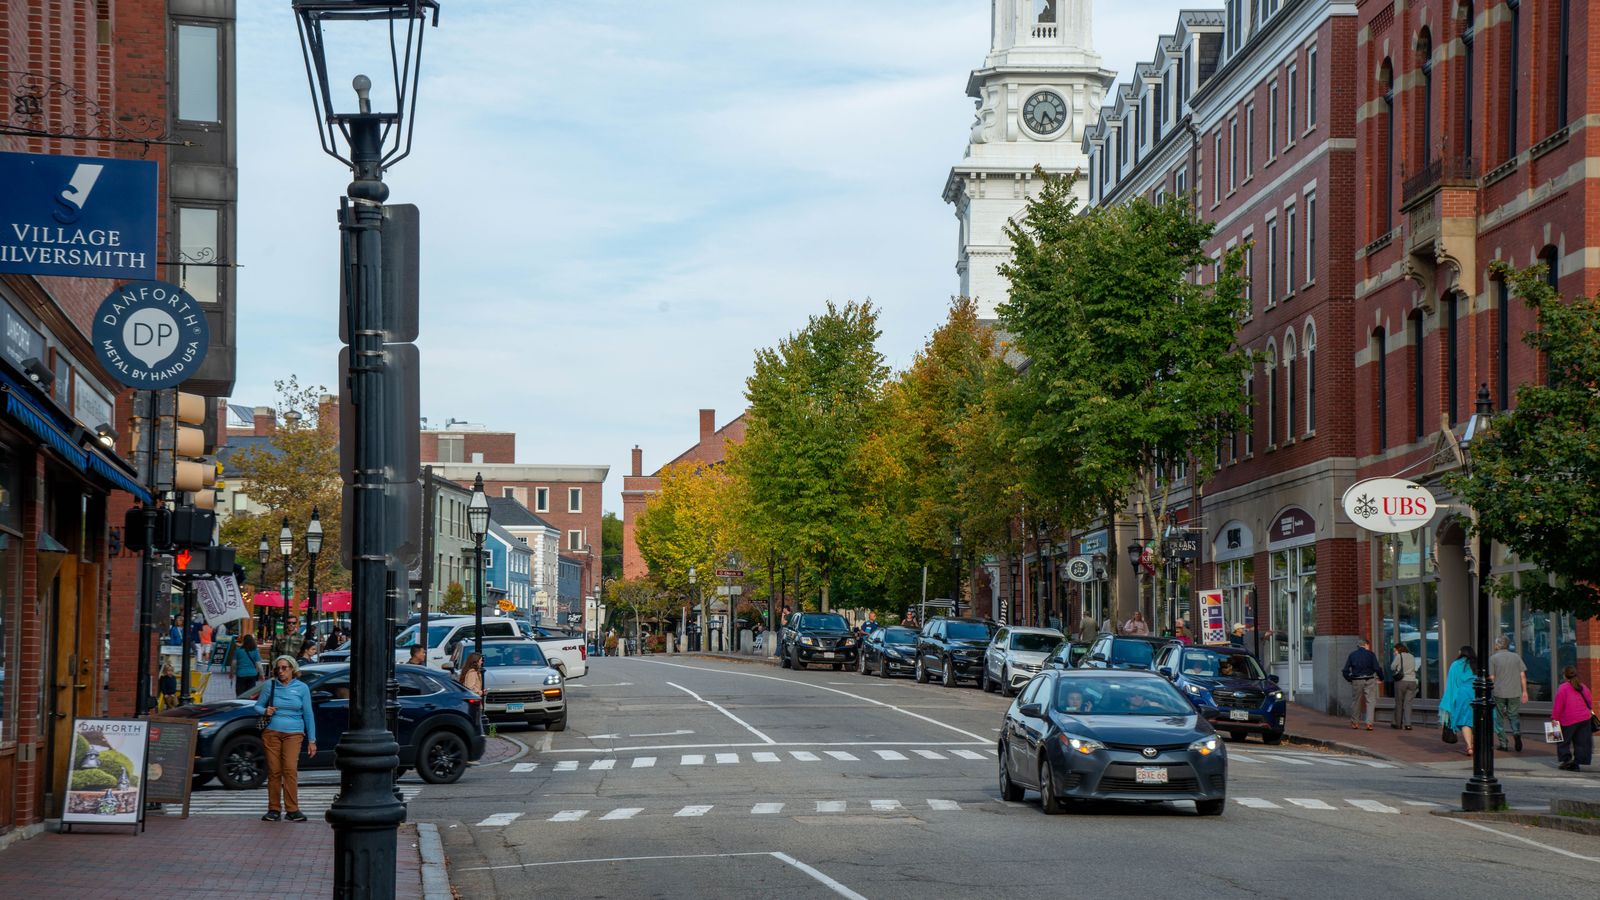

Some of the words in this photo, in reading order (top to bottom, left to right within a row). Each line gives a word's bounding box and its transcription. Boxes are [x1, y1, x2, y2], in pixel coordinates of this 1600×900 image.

[12, 223, 121, 247] VILLAGE
[0, 246, 146, 269] ILVERSMITH
[103, 287, 199, 328] DANFORTH
[134, 322, 173, 347] DP
[103, 339, 129, 374] METAL
[131, 369, 148, 382] BY
[151, 361, 185, 382] HAND
[182, 341, 200, 363] USA
[1382, 496, 1428, 516] UBS
[222, 574, 237, 607] NETT'S
[1201, 596, 1210, 640] OPEN
[81, 723, 141, 733] DANFORTH
